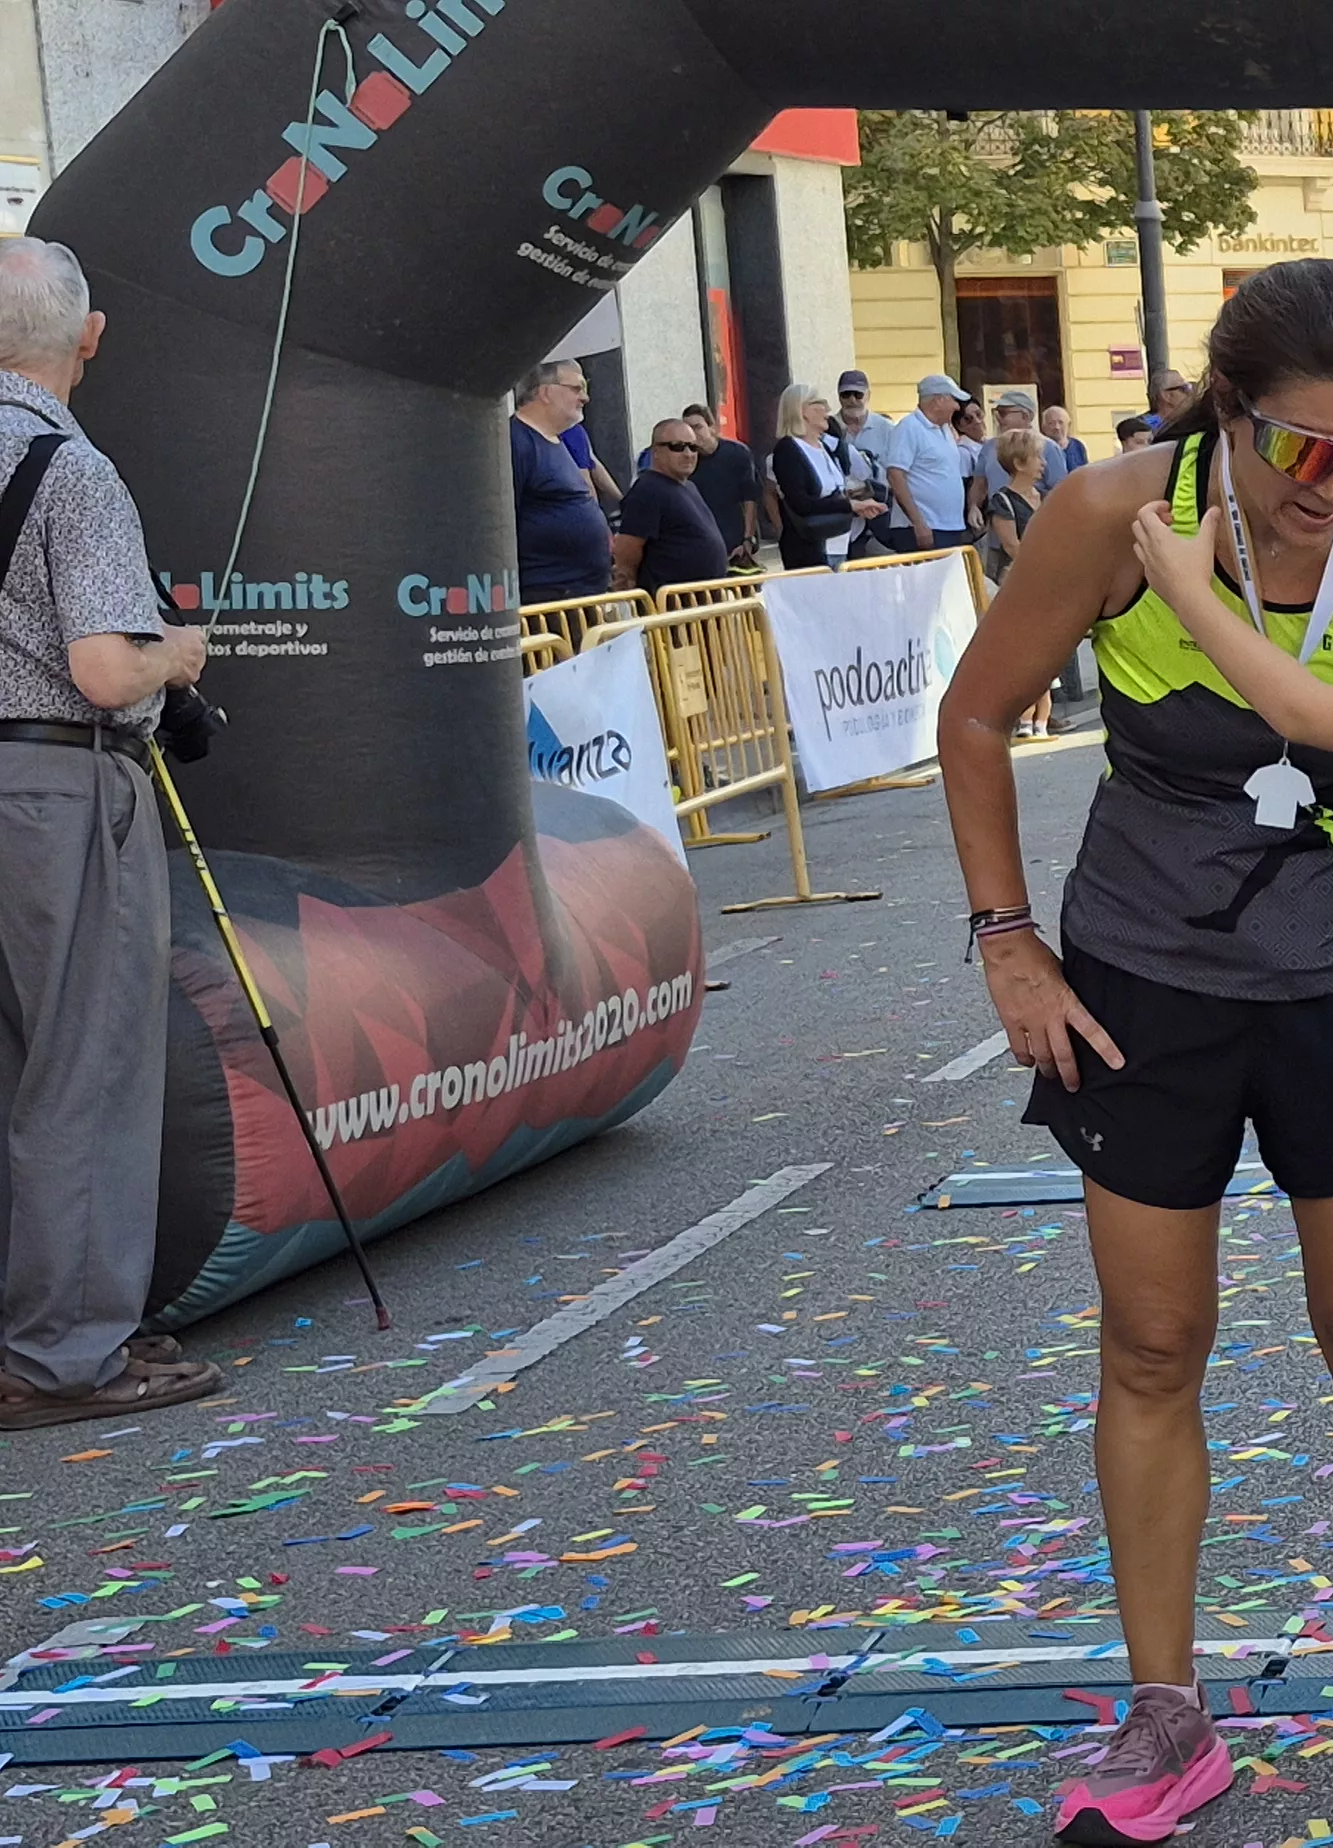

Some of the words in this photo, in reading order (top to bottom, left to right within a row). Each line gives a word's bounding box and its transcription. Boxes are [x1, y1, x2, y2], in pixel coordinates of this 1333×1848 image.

[296, 623, 309, 638] y
[429, 626, 479, 643] Servicio
[235, 640, 329, 659] deportivos
[422, 648, 473, 668] gestión
[304, 969, 694, 1151] www.cronolimits2020.com
